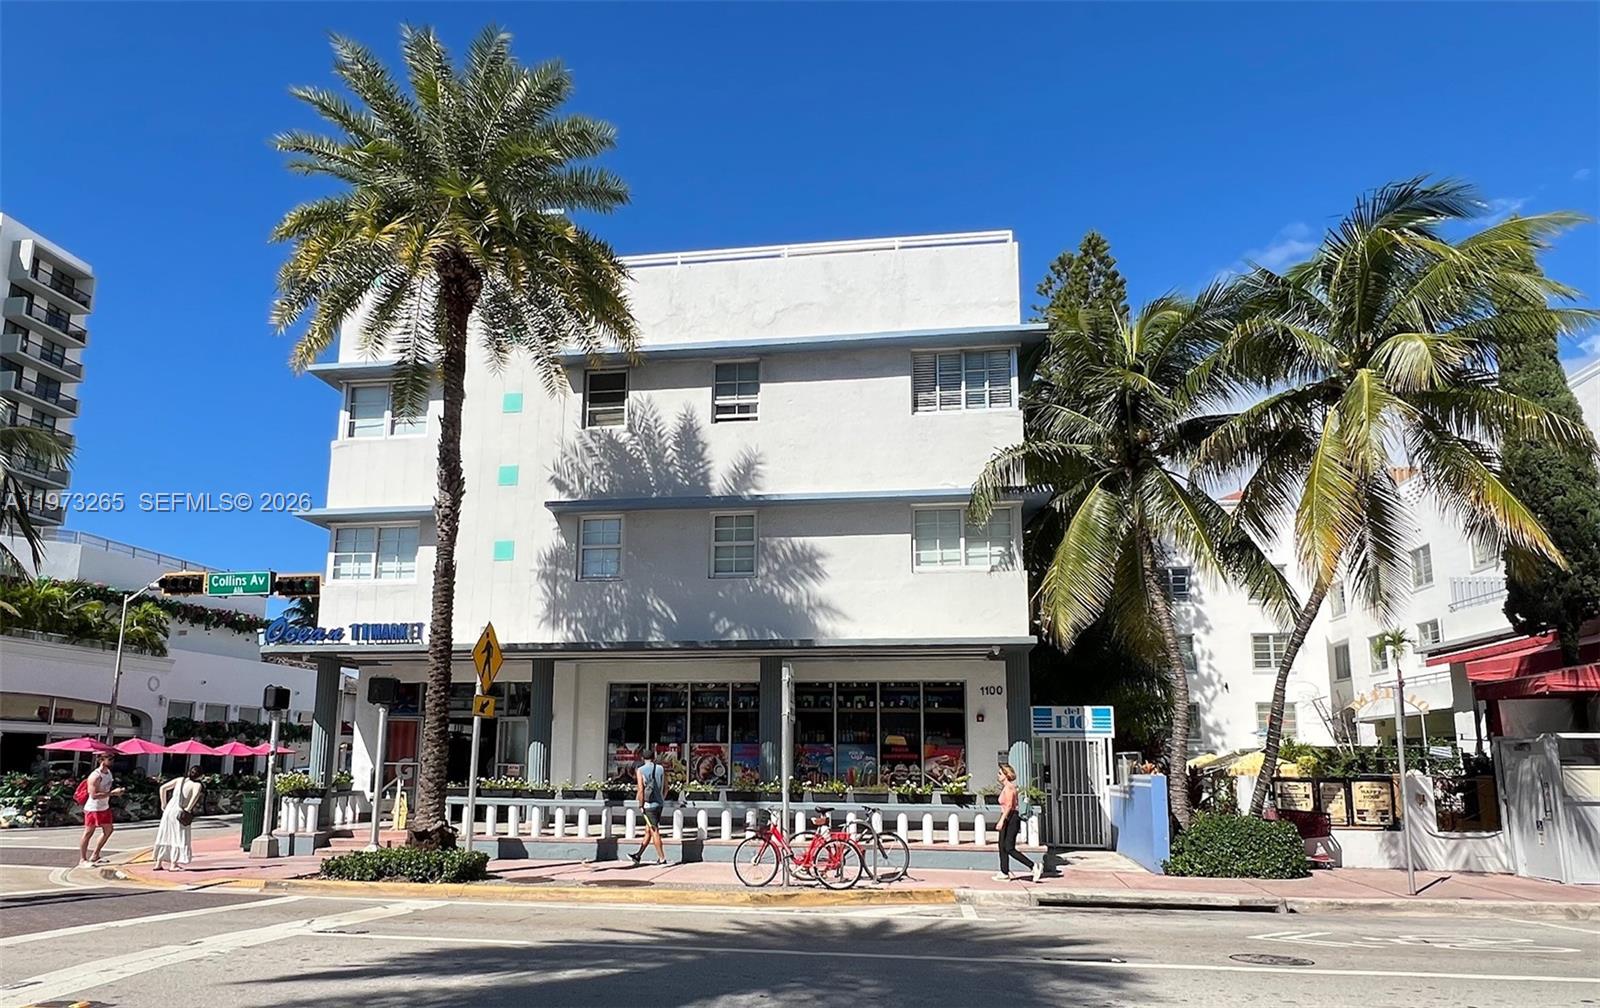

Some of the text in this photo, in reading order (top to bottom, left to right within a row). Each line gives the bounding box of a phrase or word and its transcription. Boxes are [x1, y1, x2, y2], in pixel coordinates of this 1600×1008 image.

[211, 574, 266, 587] Collins Av
[265, 616, 345, 642] Ocean
[980, 685, 1003, 696] 1100
[1064, 707, 1080, 715] del
[1056, 715, 1089, 729] RIO
